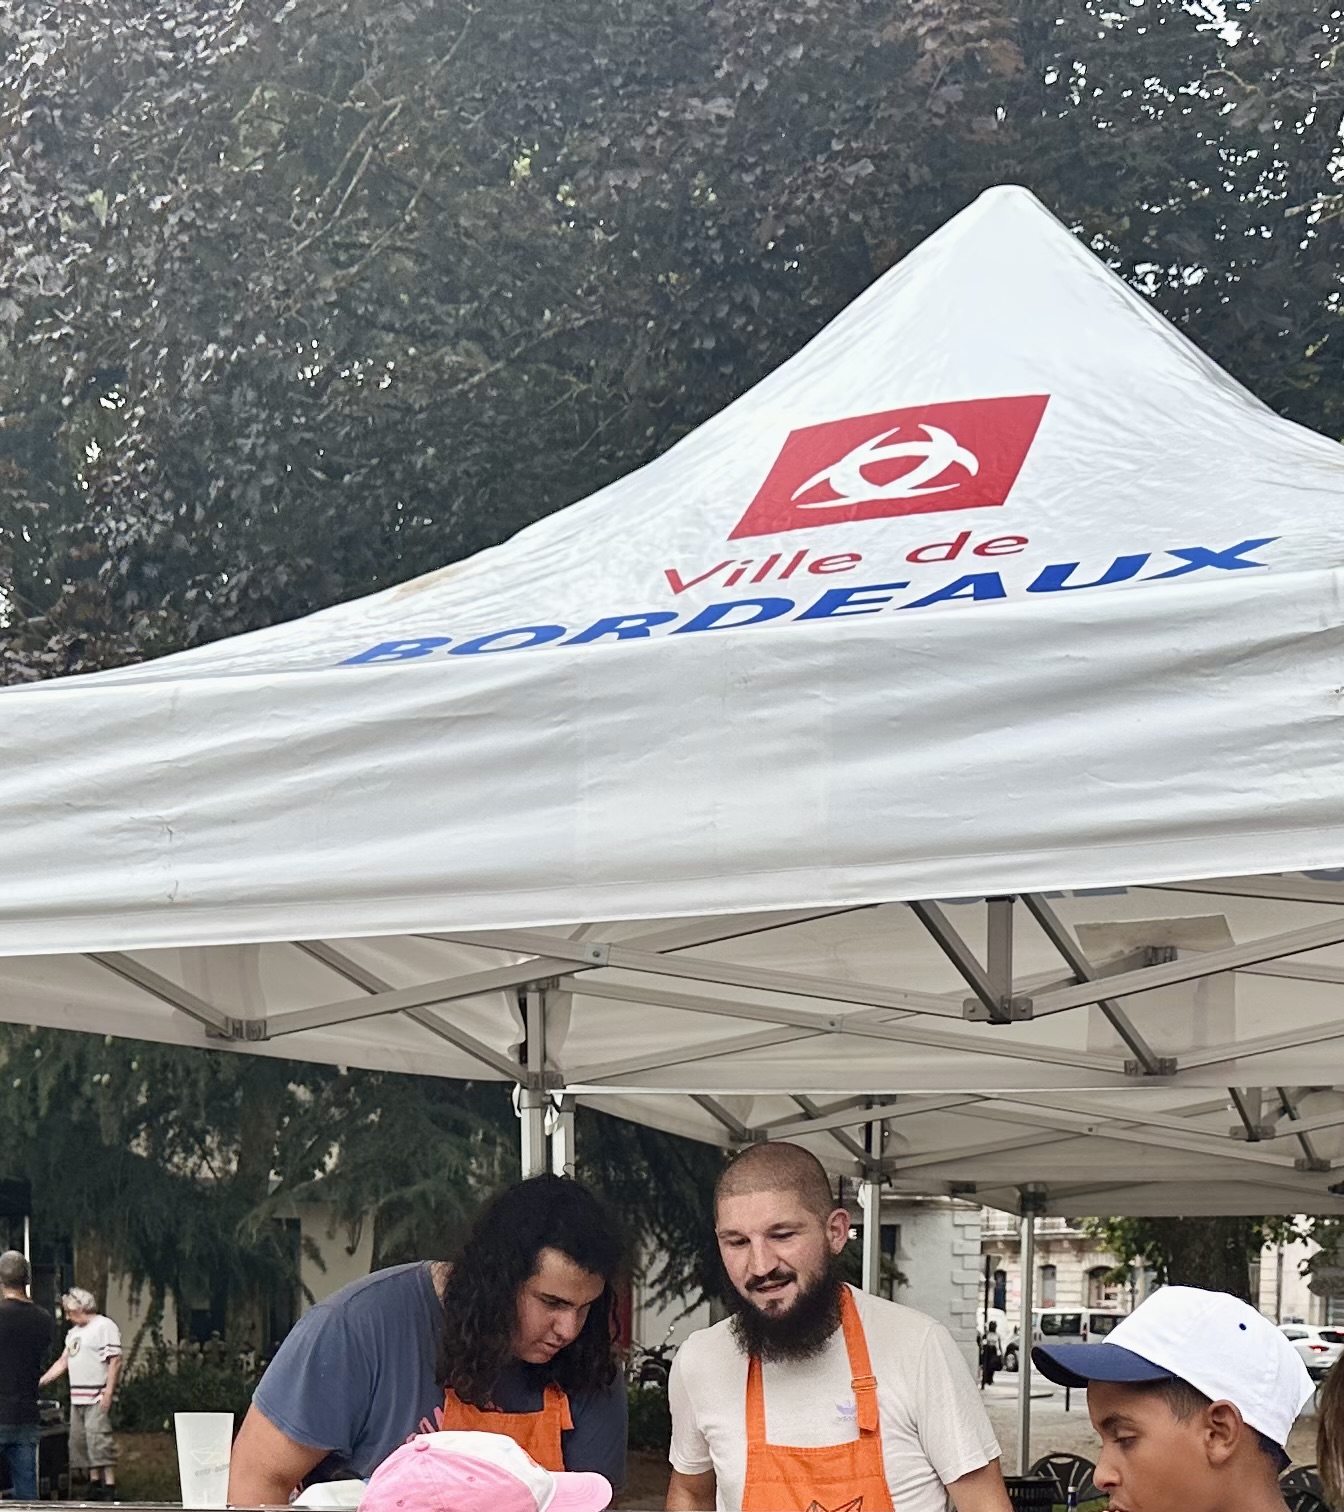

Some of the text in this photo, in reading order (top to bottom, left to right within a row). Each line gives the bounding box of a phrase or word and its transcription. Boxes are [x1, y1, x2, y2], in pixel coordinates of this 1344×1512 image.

[336, 537, 1279, 665] BORDEAUX
[665, 531, 1030, 594] Ville de
